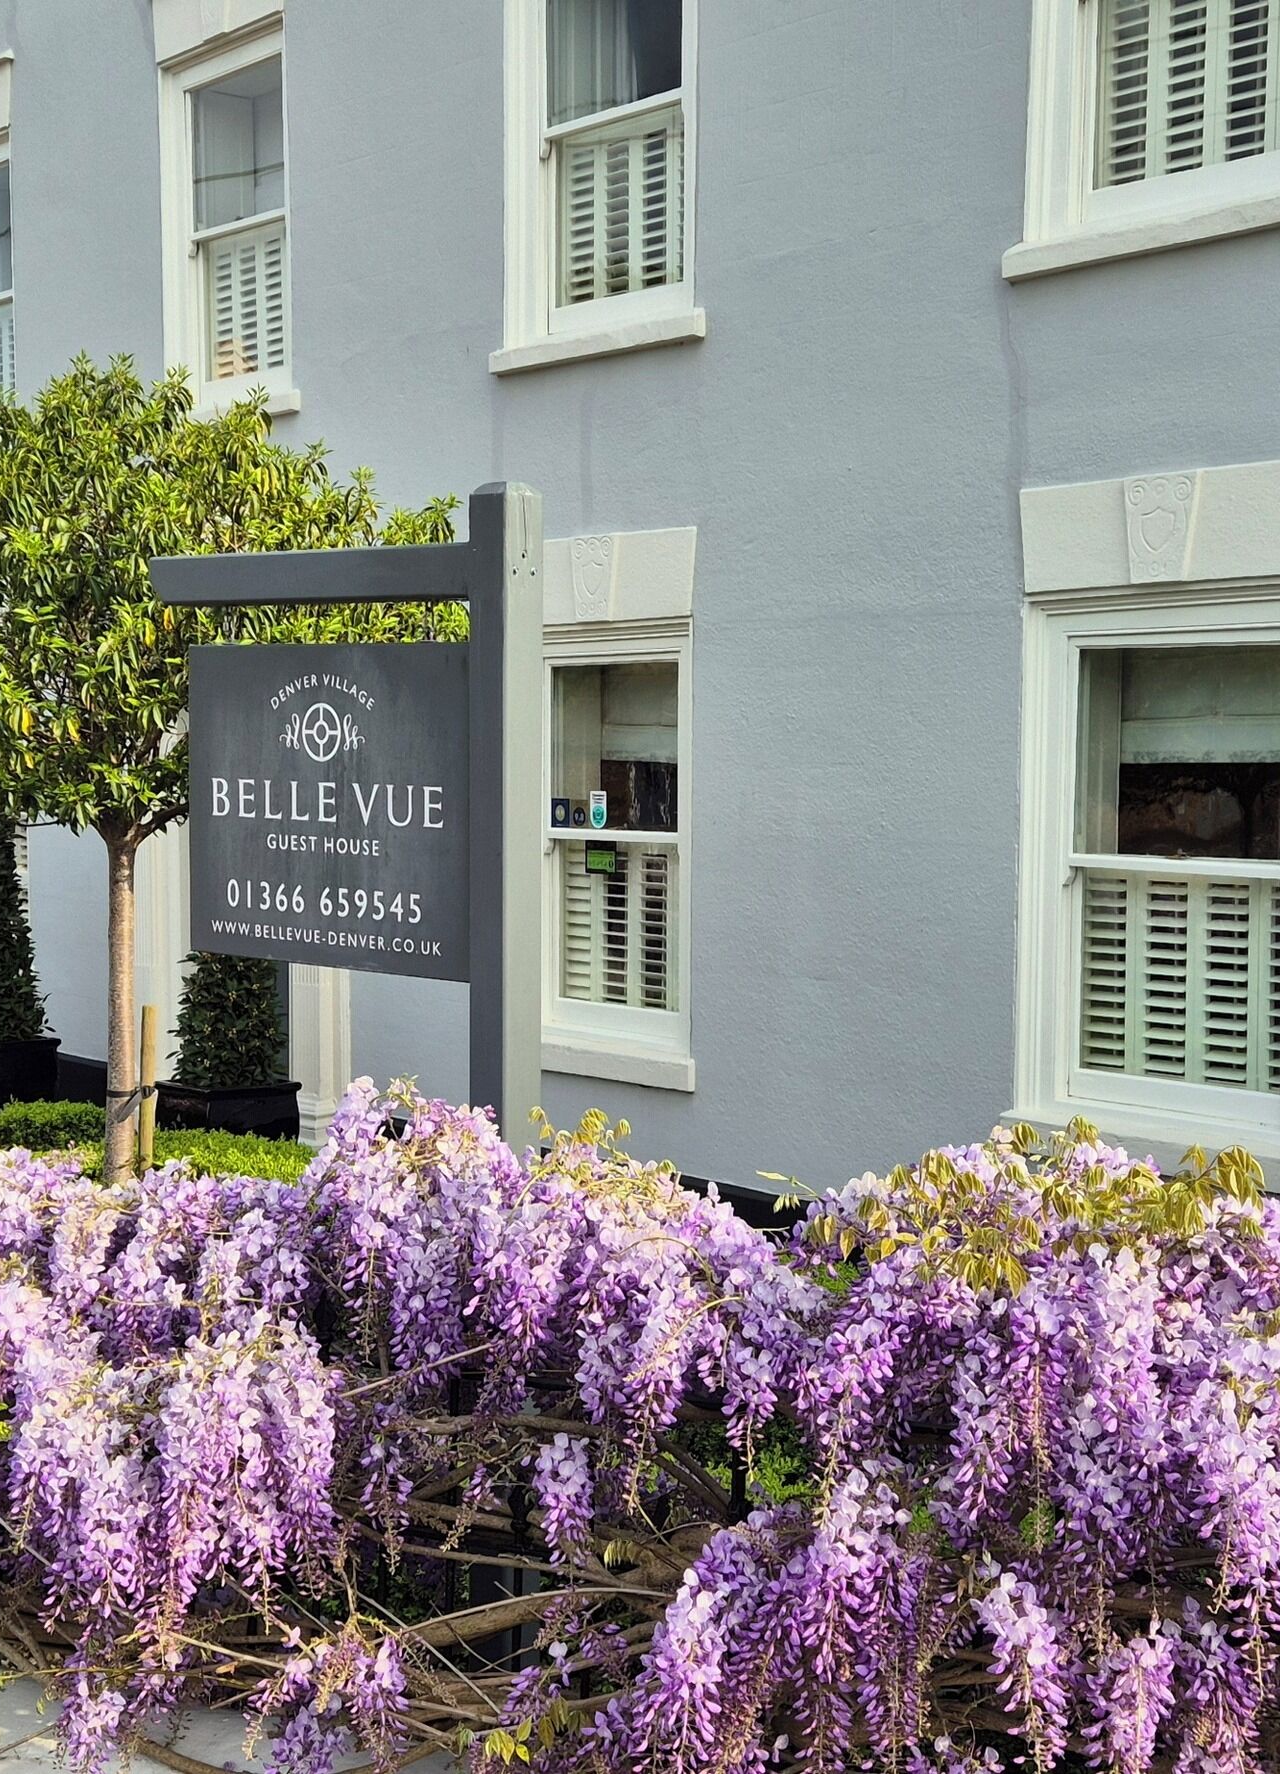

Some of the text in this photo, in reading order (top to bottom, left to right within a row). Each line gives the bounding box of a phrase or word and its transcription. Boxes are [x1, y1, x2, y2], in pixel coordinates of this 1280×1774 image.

[270, 673, 375, 711] DENVER VILLAGE
[211, 777, 444, 829] BELLE VUE
[266, 833, 380, 857] GUEST HOUSE
[227, 878, 422, 924] 01366 659545
[211, 919, 442, 957] WWW.BELLEVUE-DENVER.CO.UK
